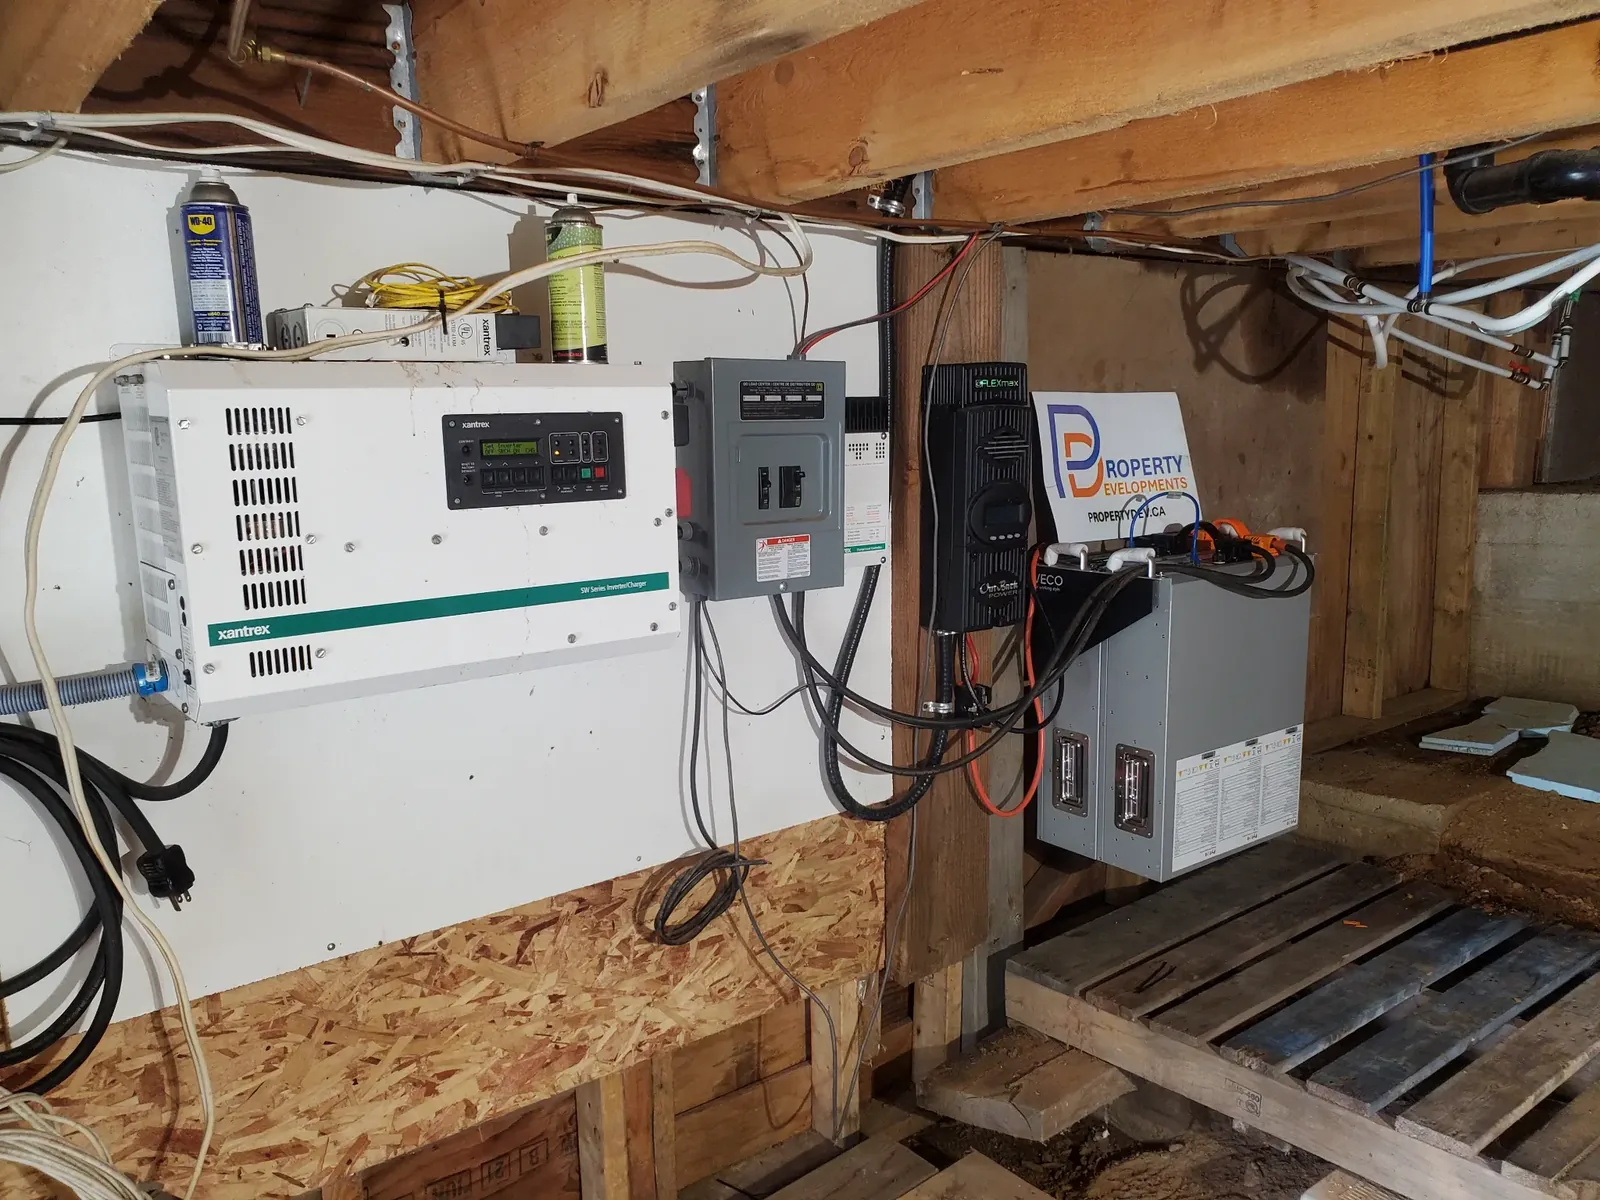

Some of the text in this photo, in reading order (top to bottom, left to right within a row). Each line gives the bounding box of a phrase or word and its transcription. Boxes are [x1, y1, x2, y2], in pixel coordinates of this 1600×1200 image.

[190, 216, 213, 225] WD-40
[482, 318, 491, 356] xantrex
[461, 421, 490, 429] xantrex
[1088, 506, 1167, 523] PROPERTYDEV.CA
[580, 580, 648, 594] SW Series Inverter/Charger
[988, 589, 1018, 599] POWER
[217, 622, 271, 641] xantrex
